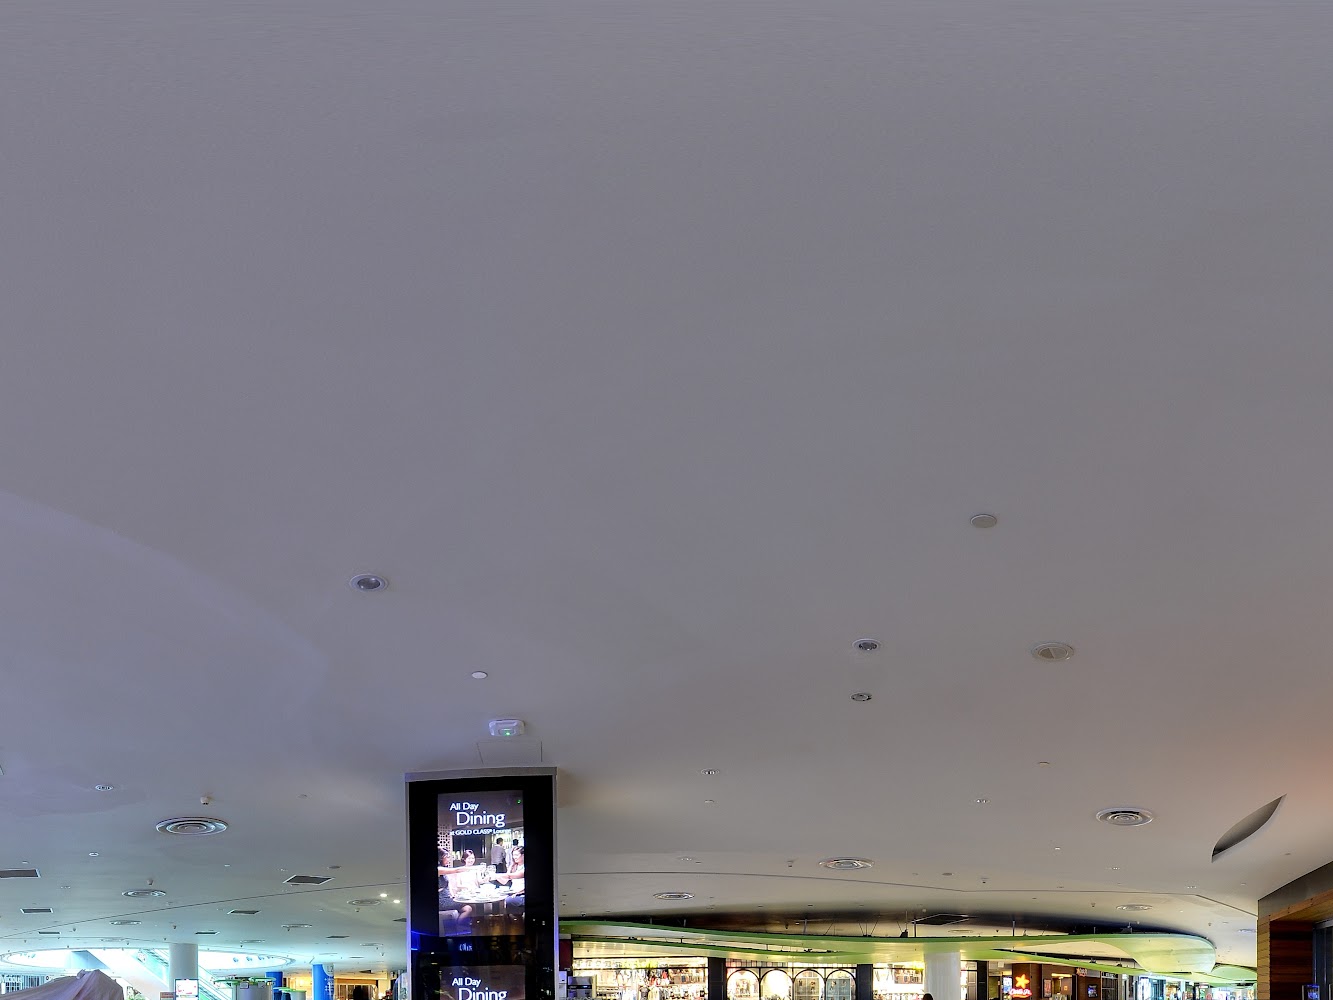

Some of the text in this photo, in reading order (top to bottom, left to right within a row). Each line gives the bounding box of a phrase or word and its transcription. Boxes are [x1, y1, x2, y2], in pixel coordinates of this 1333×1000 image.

[450, 802, 479, 812] All Day
[456, 811, 506, 828] Dining
[452, 977, 481, 988] All Day
